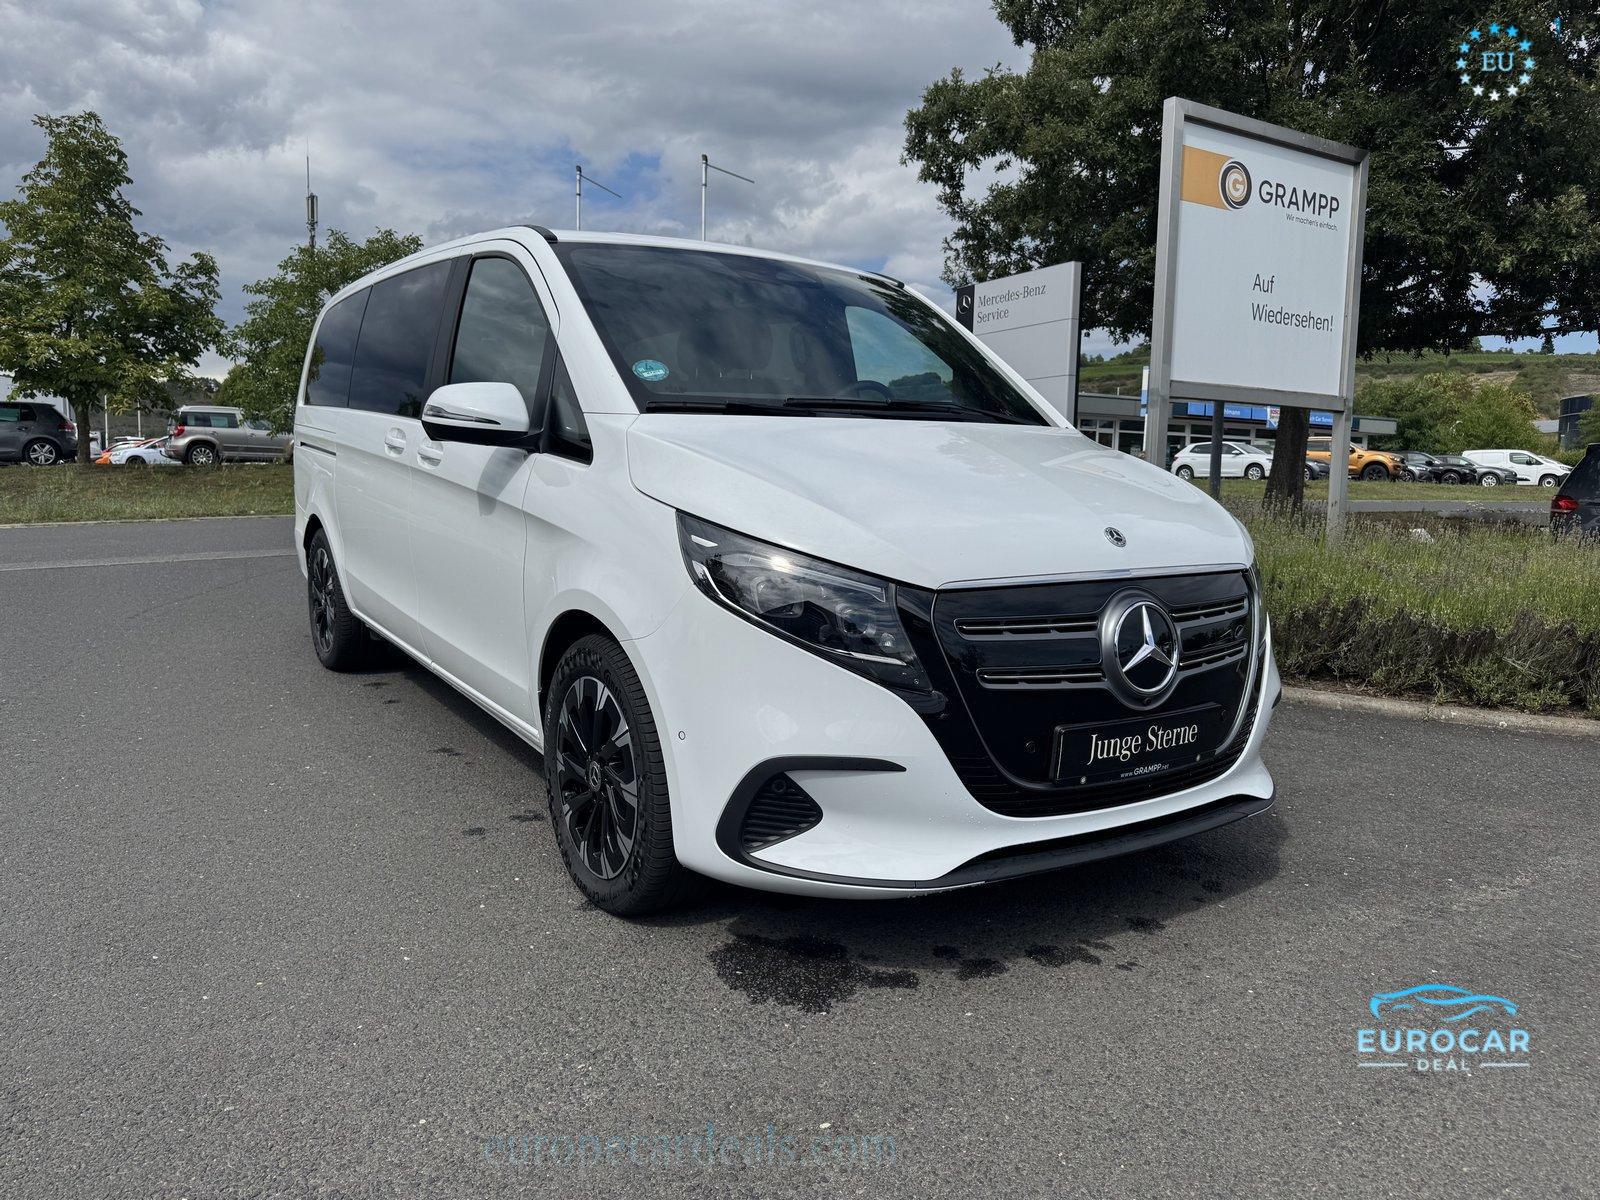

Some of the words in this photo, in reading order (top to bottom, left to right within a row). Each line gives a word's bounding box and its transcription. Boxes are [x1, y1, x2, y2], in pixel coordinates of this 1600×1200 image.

[1258, 180, 1340, 219] GRAMPP
[1252, 273, 1275, 293] Auf
[978, 285, 1047, 308] Mercedes-Benz
[977, 308, 1009, 323] Service
[1251, 302, 1334, 332] Wiedersehen!
[1087, 734, 1141, 765] Junge
[1145, 724, 1198, 752] Sterne
[1120, 763, 1169, 777] www.GRAMPP.net
